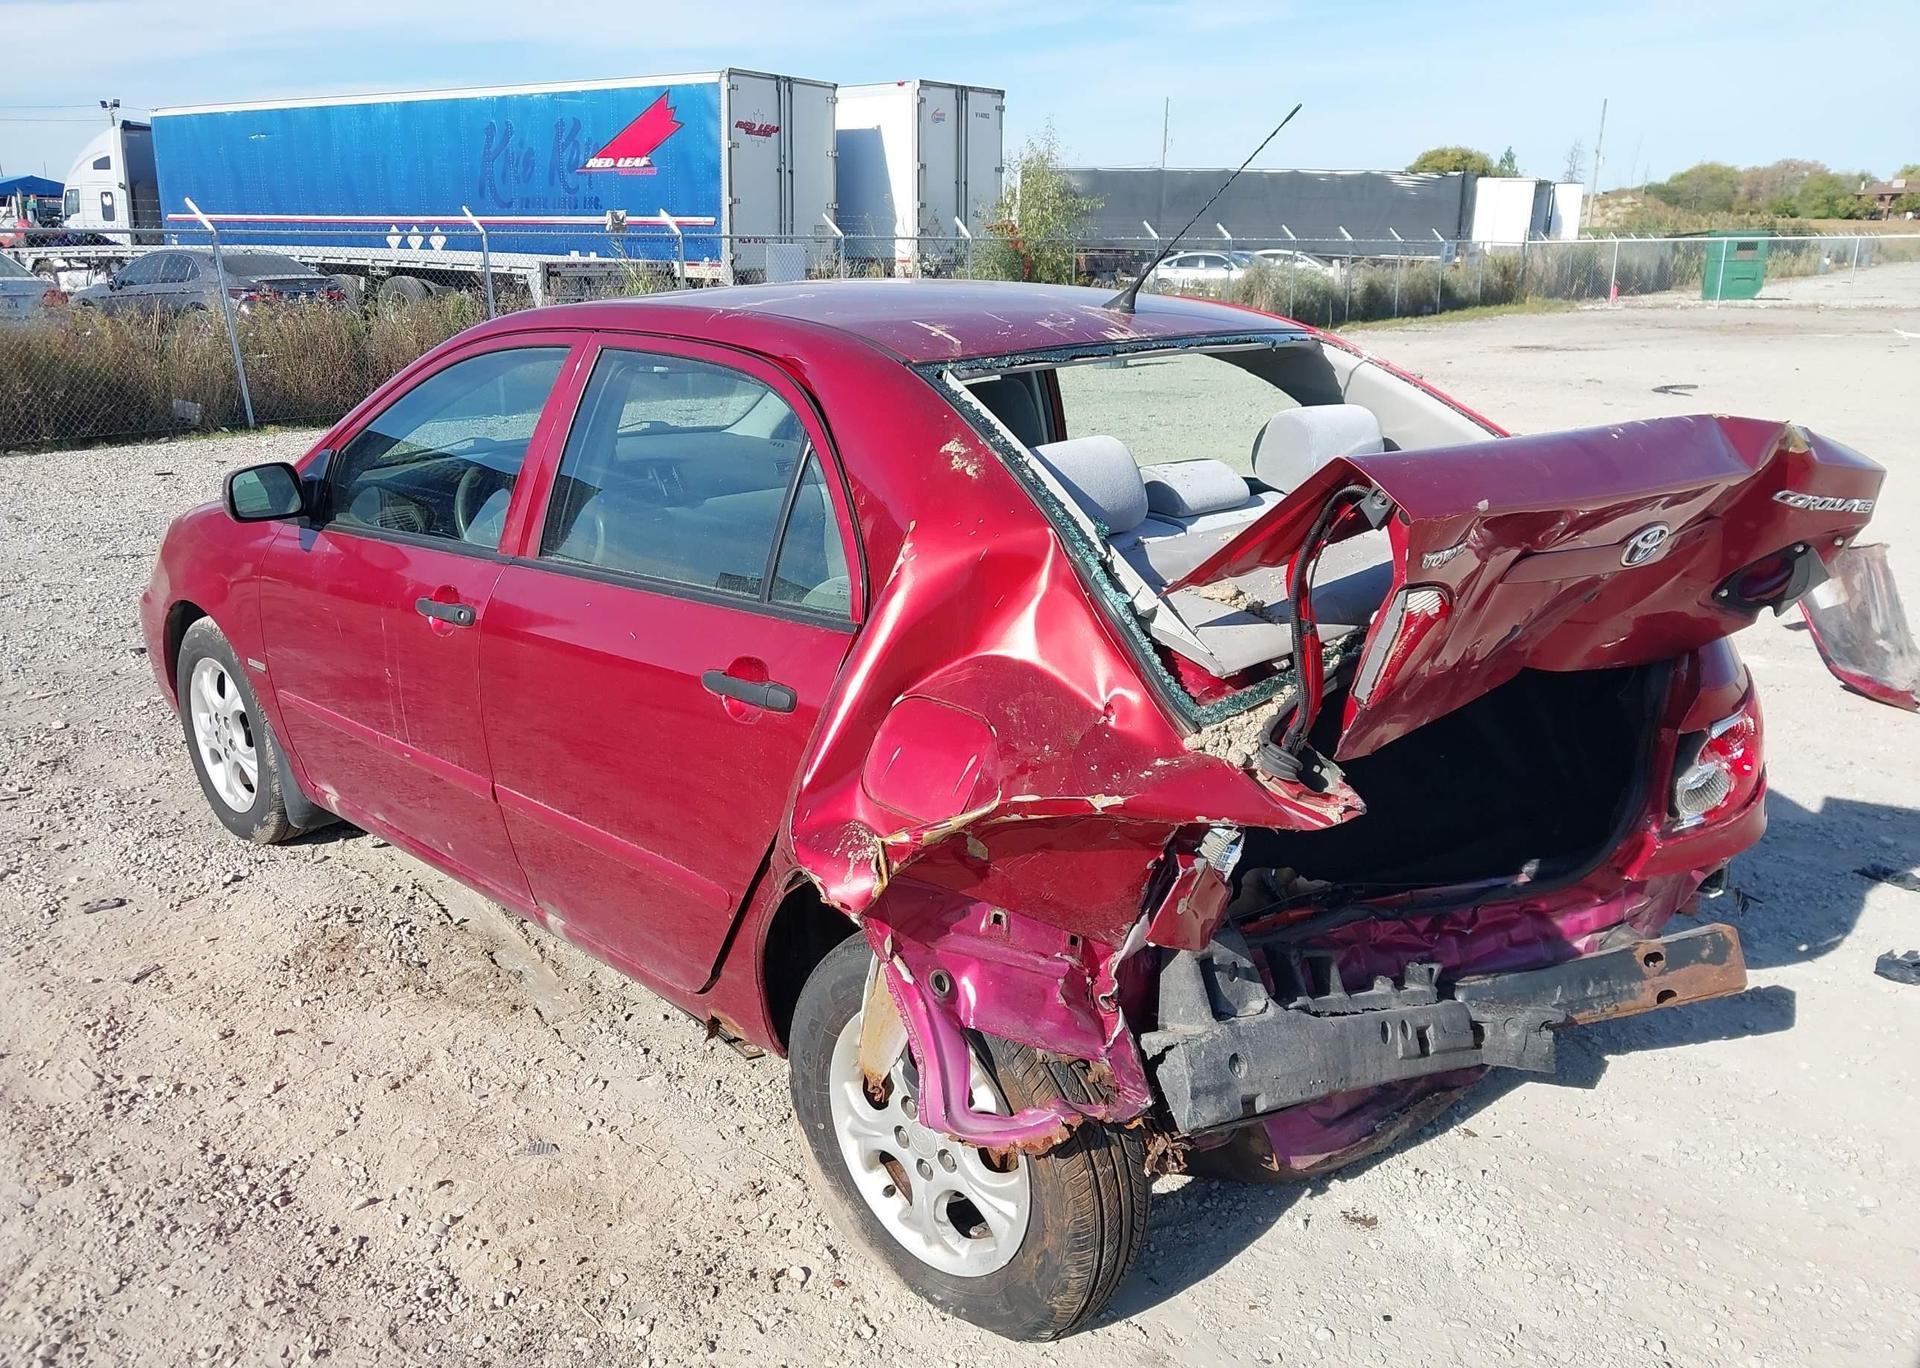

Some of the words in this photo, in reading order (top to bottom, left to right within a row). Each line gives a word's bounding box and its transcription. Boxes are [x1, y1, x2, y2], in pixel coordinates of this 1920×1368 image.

[735, 121, 757, 131] RED
[586, 157, 615, 168] RED
[616, 156, 650, 168] LEAF
[1772, 489, 1856, 513] COROLLA
